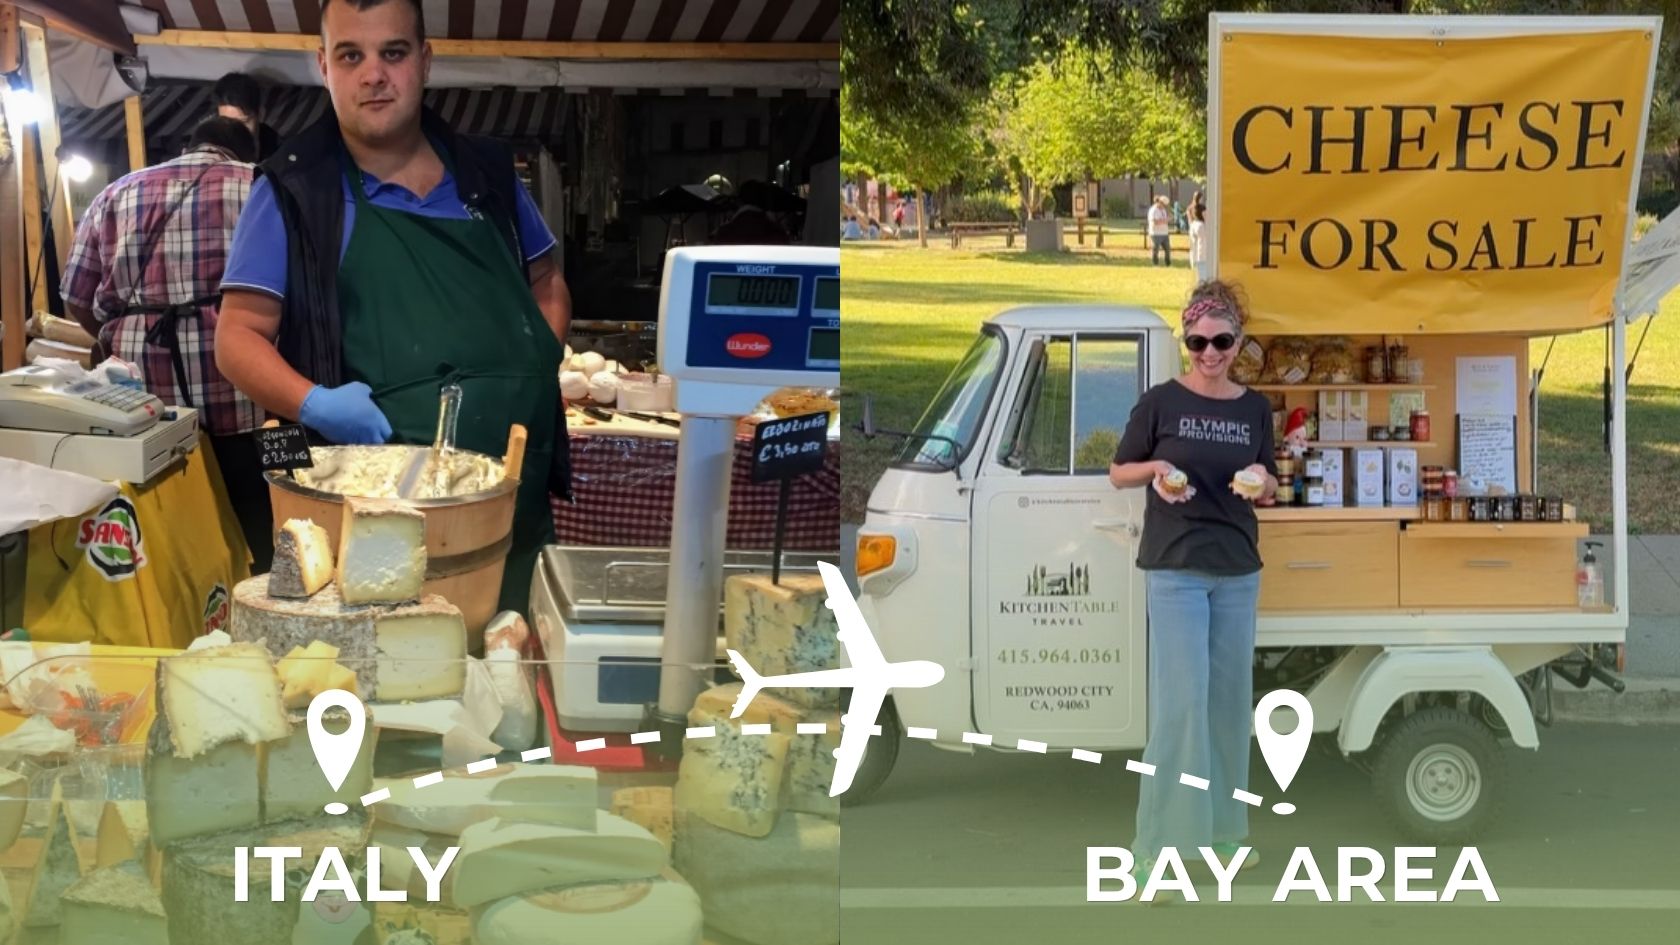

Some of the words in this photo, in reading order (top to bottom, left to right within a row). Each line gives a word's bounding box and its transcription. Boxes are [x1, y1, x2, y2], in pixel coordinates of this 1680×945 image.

[1232, 100, 1626, 175] CHEESE
[1253, 218, 1407, 272] FOR
[1425, 214, 1605, 271] SALE
[736, 264, 776, 274] WEIGHT
[726, 339, 771, 351] Wunder
[1179, 417, 1250, 436] OLYMPIC
[1178, 430, 1250, 446] PROVISIONS
[1033, 618, 1084, 626] TRAVEL
[998, 649, 1122, 664] 415.964.0361
[1005, 686, 1078, 697] REDWOOD
[1081, 686, 1115, 697] CITY
[1030, 700, 1054, 712] CA,
[1057, 700, 1090, 711] 94063
